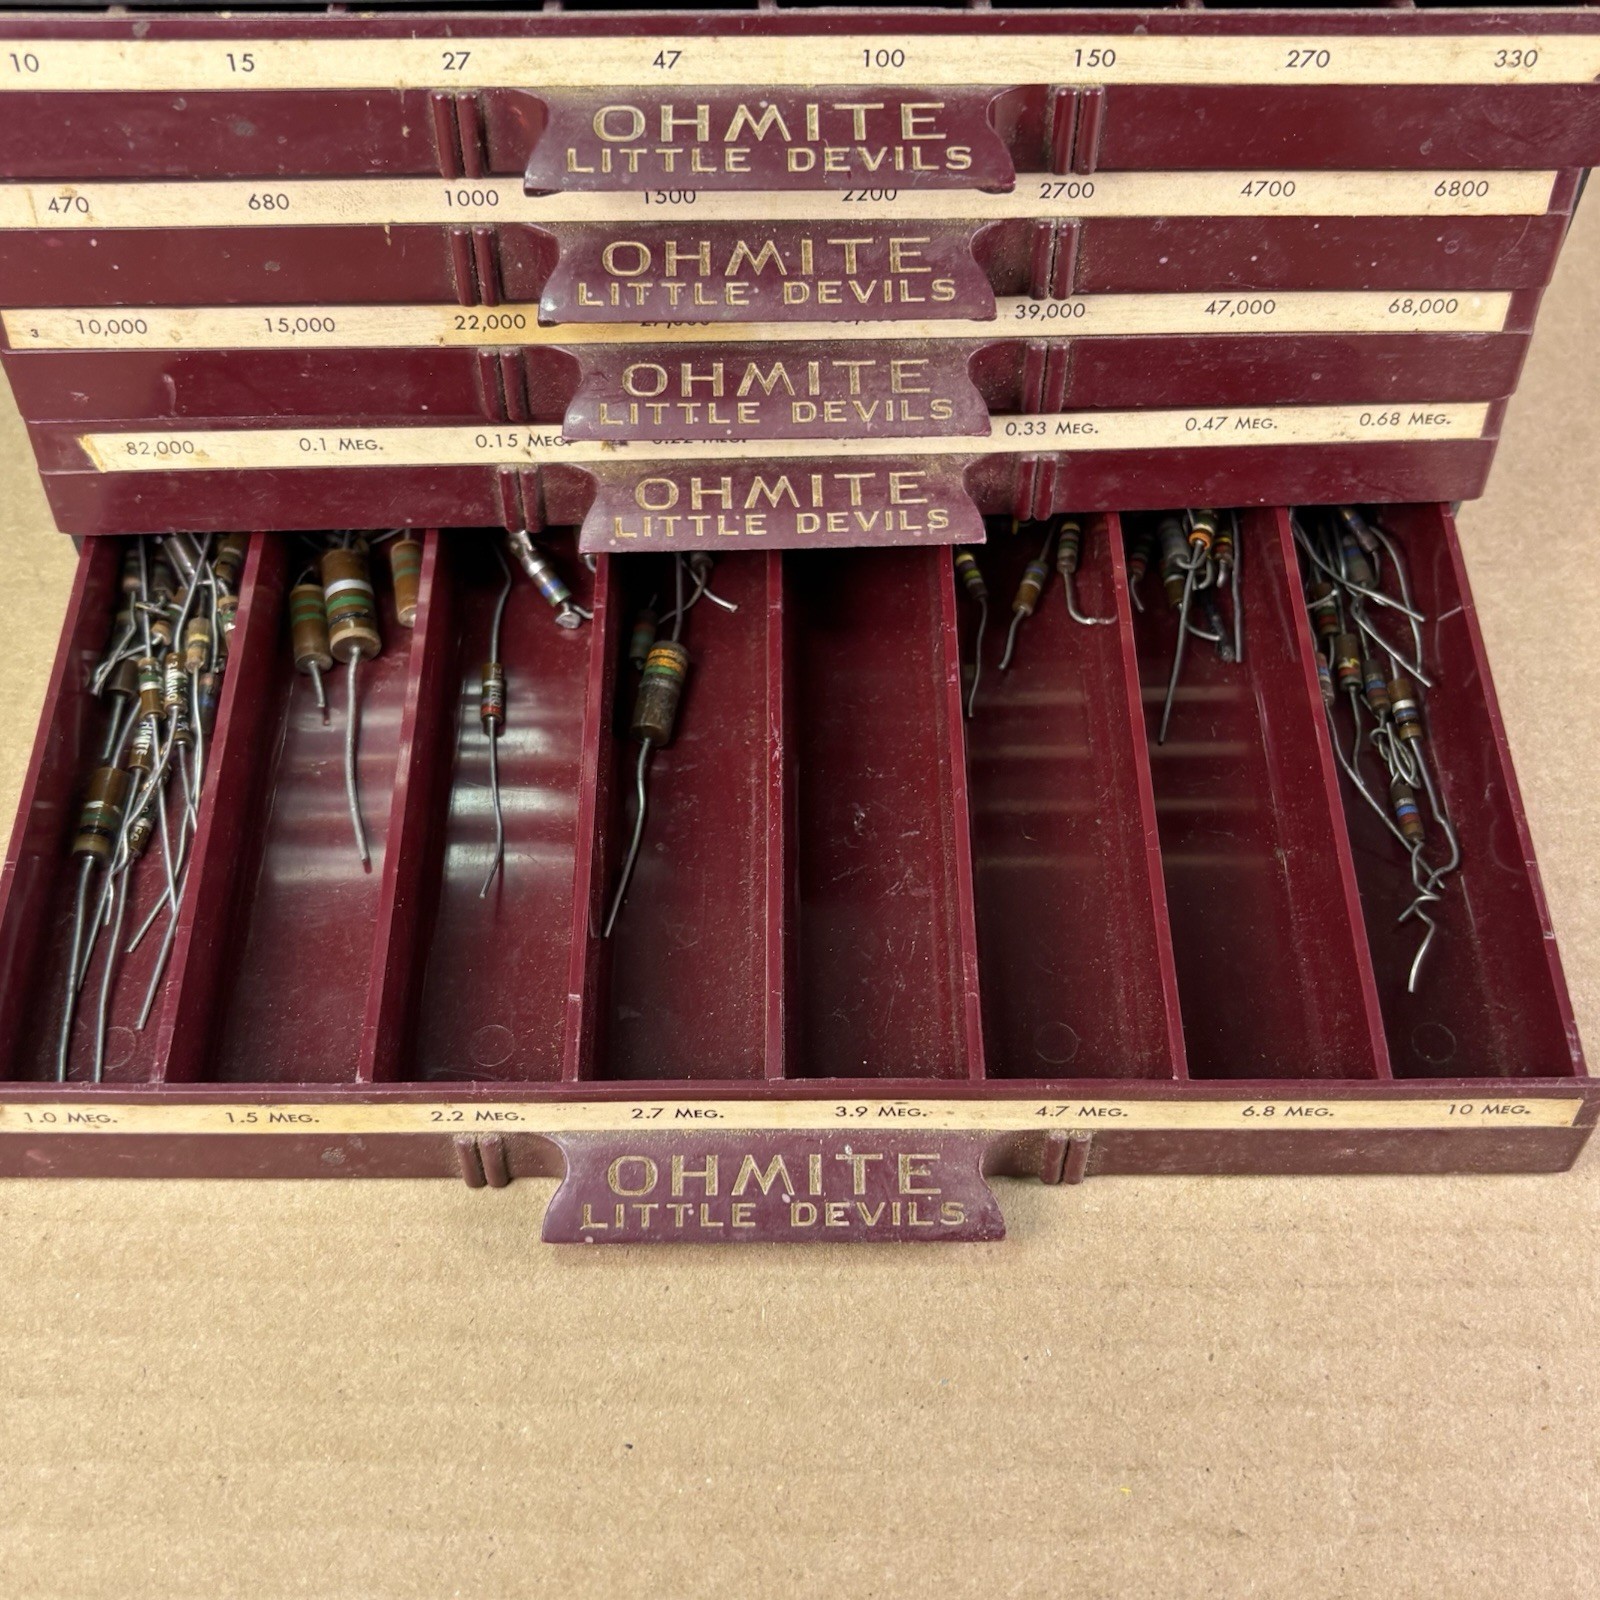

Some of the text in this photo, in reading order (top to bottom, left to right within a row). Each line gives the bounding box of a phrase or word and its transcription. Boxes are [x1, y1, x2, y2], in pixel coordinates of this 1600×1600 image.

[9, 53, 40, 73] 10
[226, 53, 255, 73] 15
[442, 51, 471, 71] 27
[652, 49, 683, 70] 47
[863, 48, 906, 68] 100
[1075, 48, 1117, 68] 150
[1285, 49, 1331, 69] 270
[1494, 49, 1539, 68] 330
[592, 102, 946, 143] OHMITE
[567, 146, 973, 173] LITTLE DEVILS
[444, 189, 499, 207] 1000
[1039, 181, 1095, 199] 2700
[1240, 180, 1296, 198] 4700
[1434, 180, 1489, 197] 6800
[48, 194, 90, 214] 470
[248, 193, 290, 211] 680
[602, 237, 932, 277] OHMITE
[578, 281, 958, 306] LITTLE DEVILS
[1014, 301, 1087, 320] 39,000
[1204, 299, 1276, 318] 47,000
[1388, 298, 1459, 316] 68,000
[76, 318, 148, 337] 10,000
[264, 317, 336, 336] 15,000
[454, 313, 526, 333] 22,000
[30, 328, 40, 338] 3
[622, 359, 931, 397] OHMITE
[600, 399, 953, 426] LITTLE DEVILS
[1359, 411, 1451, 427] 0.68 MEG.
[1005, 421, 1099, 437] 0.33 MEG.
[1185, 416, 1278, 432] 0.47 MEG.
[126, 440, 195, 457] 82,000
[299, 437, 384, 452] 0.1 MEG.
[475, 433, 518, 449] 0.15
[634, 471, 928, 511] OHMITE
[614, 508, 950, 538] LITTLE DEVILS
[24, 1112, 118, 1124] 1.0 MEG.
[225, 1112, 320, 1124] 1.5 MEG.
[430, 1110, 526, 1122] 2.2 MEG.
[631, 1107, 725, 1119] 2.7 MEG.
[835, 1106, 928, 1118] 3.9 MEG.
[1035, 1105, 1128, 1117] 4.7 MEG.
[1241, 1105, 1334, 1117] 6.8 MEG.
[1449, 1103, 1531, 1115] 10 MEG.
[607, 1153, 942, 1197] OHMITE
[582, 1201, 966, 1230] LITTLE DEVILS
